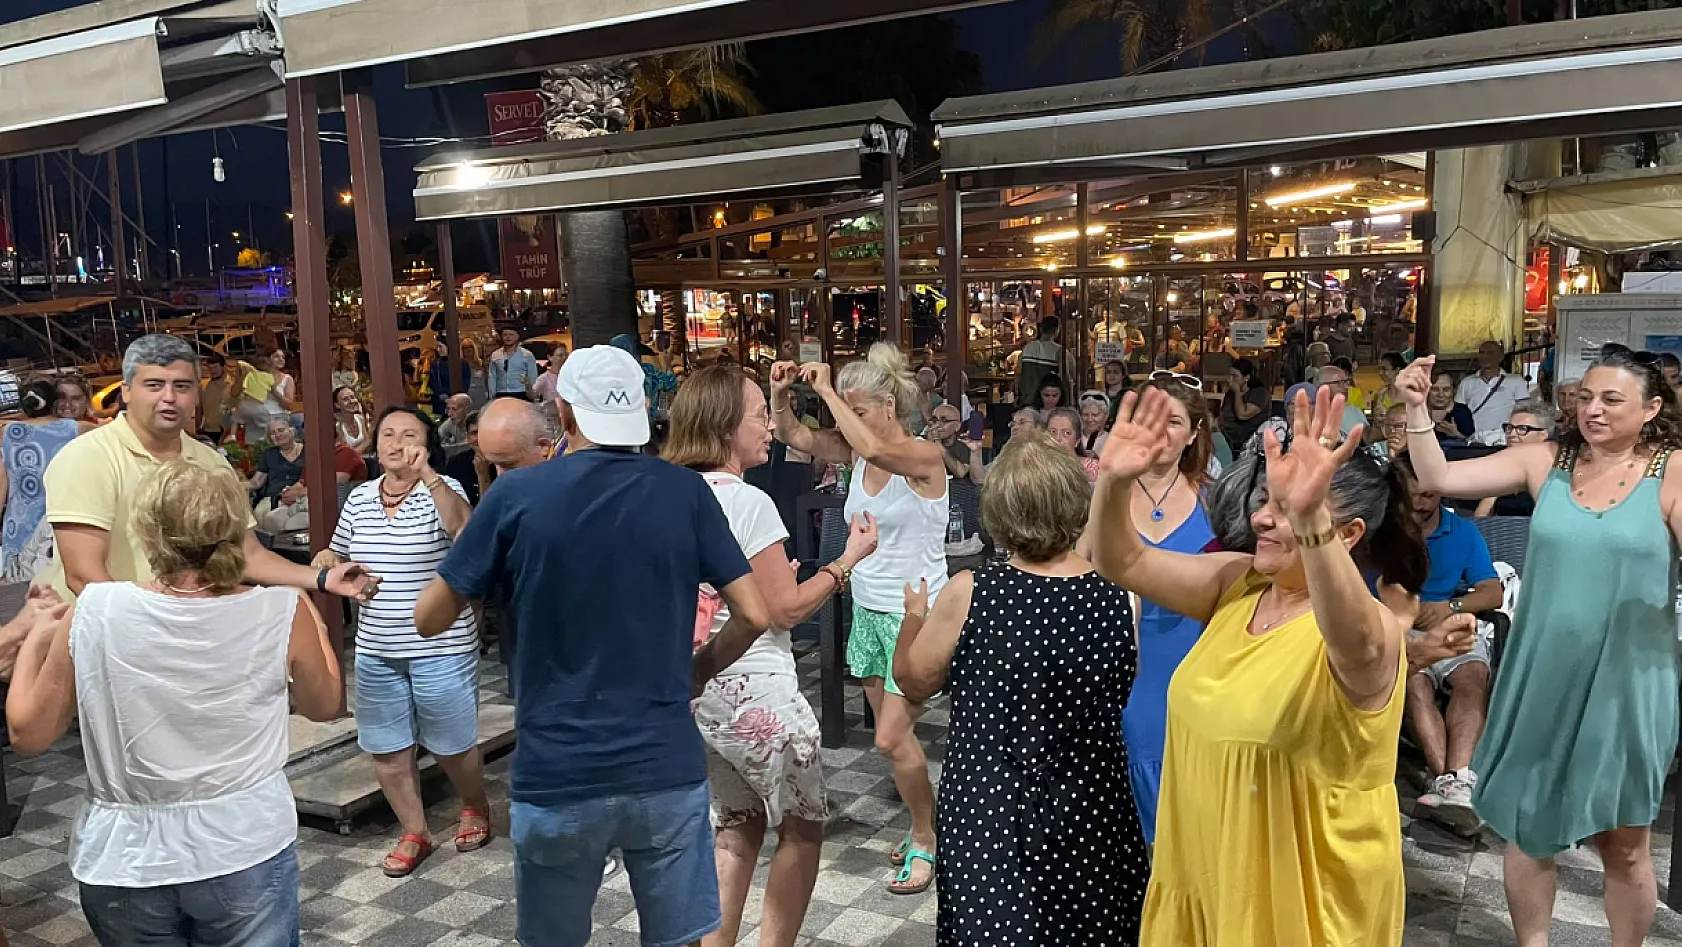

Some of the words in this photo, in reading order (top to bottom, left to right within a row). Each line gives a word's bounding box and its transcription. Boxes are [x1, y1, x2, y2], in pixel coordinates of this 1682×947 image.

[494, 101, 539, 122] SERVET
[514, 252, 548, 266] TAHİN
[519, 265, 547, 279] TRÜF
